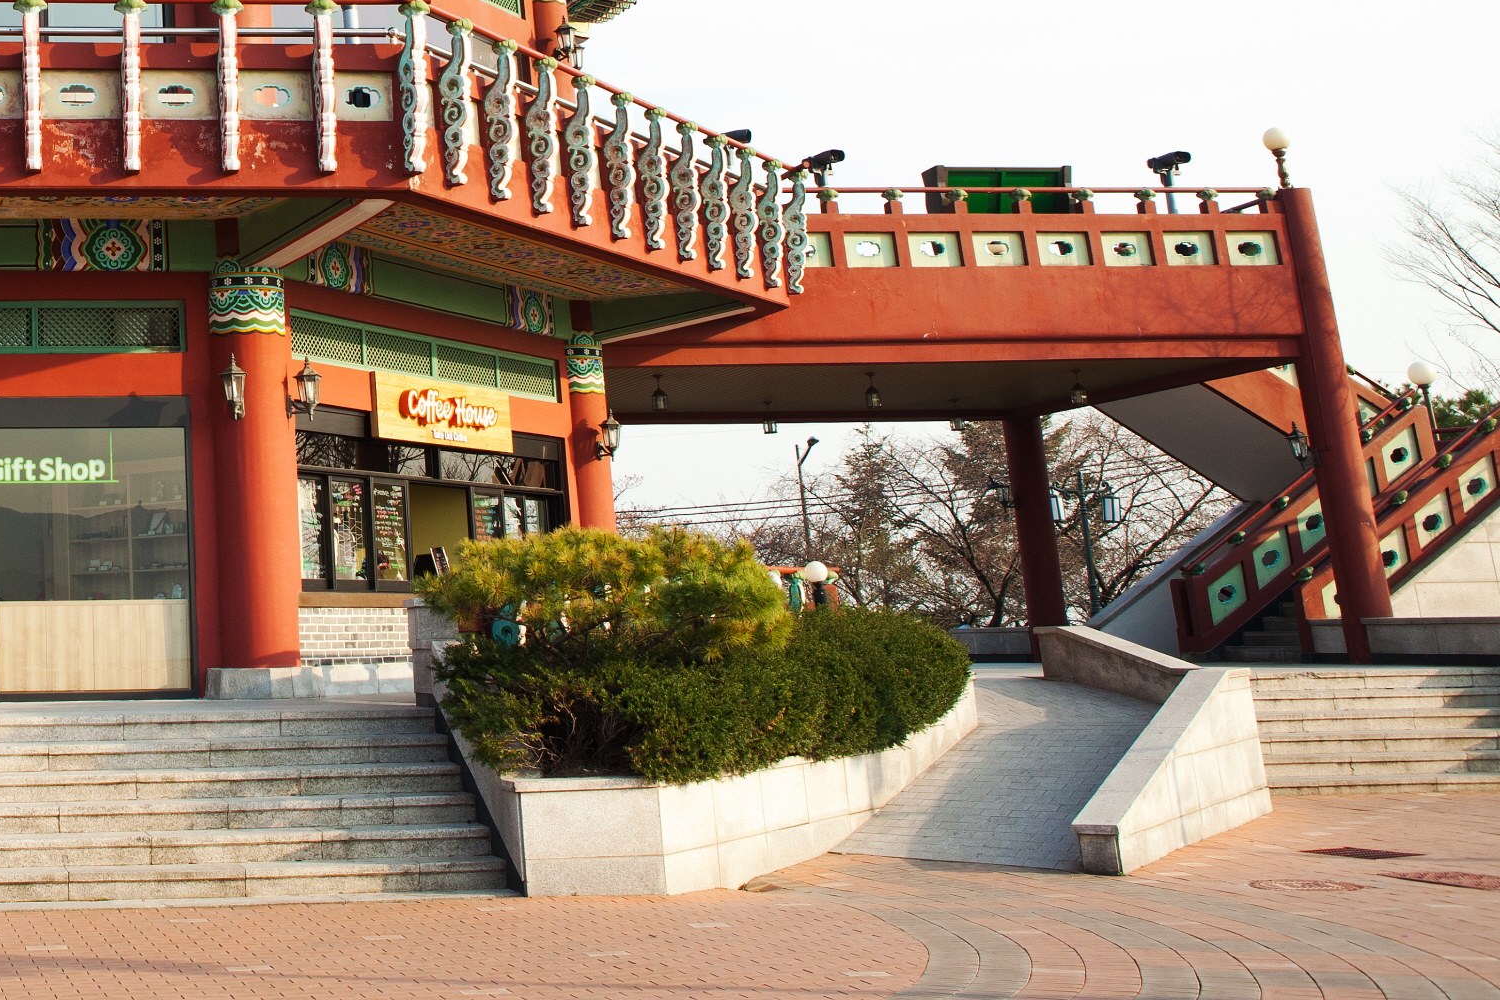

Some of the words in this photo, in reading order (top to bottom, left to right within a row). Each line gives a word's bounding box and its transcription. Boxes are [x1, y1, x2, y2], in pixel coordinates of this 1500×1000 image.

[404, 388, 454, 424] Coffee
[454, 396, 499, 428] House
[38, 456, 106, 482] Shop
